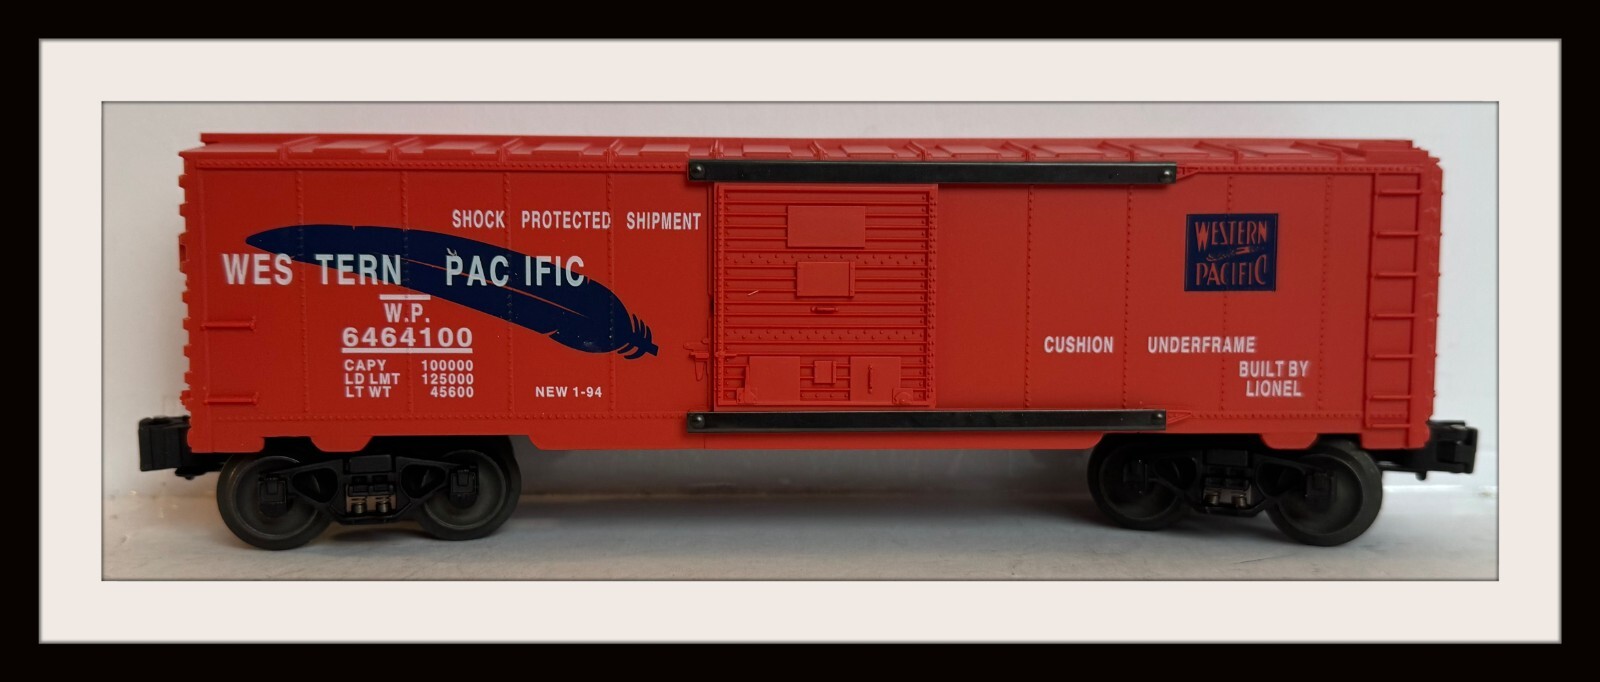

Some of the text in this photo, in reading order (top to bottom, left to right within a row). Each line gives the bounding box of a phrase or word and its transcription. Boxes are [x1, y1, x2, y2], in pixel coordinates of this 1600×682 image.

[452, 209, 702, 230] SHOCK PROTECTED SHIPMENT
[1194, 220, 1267, 251] WESTERN
[1195, 254, 1267, 286] PACIFIC
[384, 302, 430, 323] W.P.
[342, 326, 473, 348] 6464100
[1043, 335, 1256, 354] CUSHION UNDERFRAME
[344, 359, 474, 372] CAPY 100000
[1239, 360, 1309, 378] BUILT BY
[345, 372, 474, 385] LD LMT 125000
[345, 385, 474, 398] LT WT 45600
[535, 386, 602, 398] NEW 1-94
[1245, 379, 1302, 398] LIONEL
